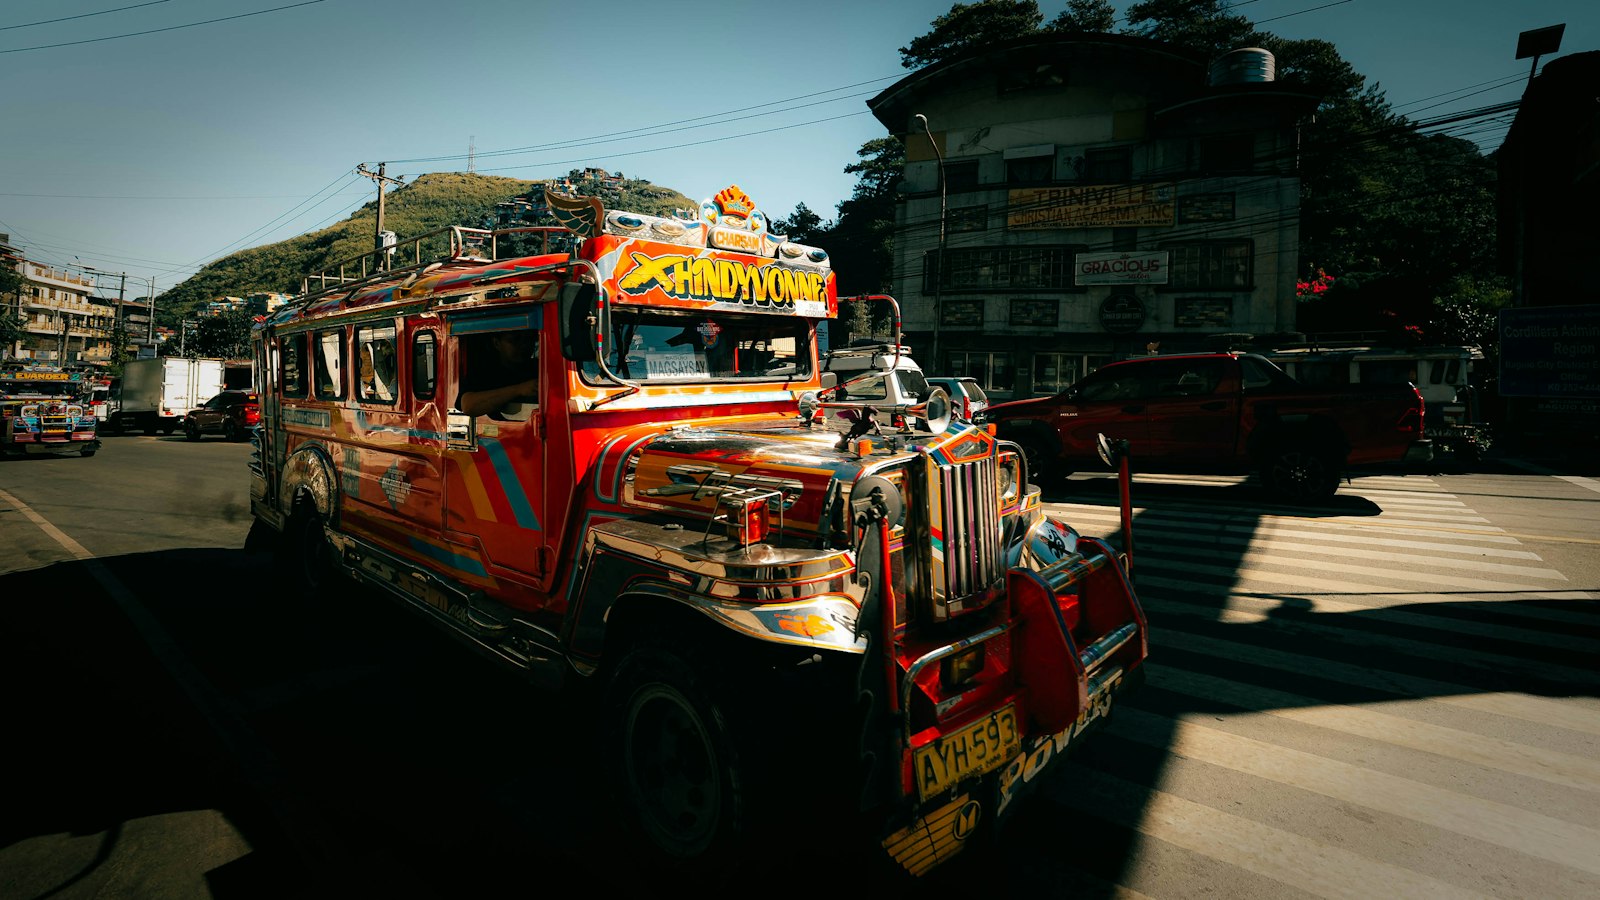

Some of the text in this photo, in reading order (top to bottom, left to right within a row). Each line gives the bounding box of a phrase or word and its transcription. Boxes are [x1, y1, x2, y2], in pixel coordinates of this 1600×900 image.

[1081, 260, 1159, 274] GRACIOUS
[1503, 324, 1559, 338] Cordillera
[1553, 342, 1595, 358] Region
[648, 361, 705, 377] MAGSAYSAY
[15, 372, 69, 381] EVANDER
